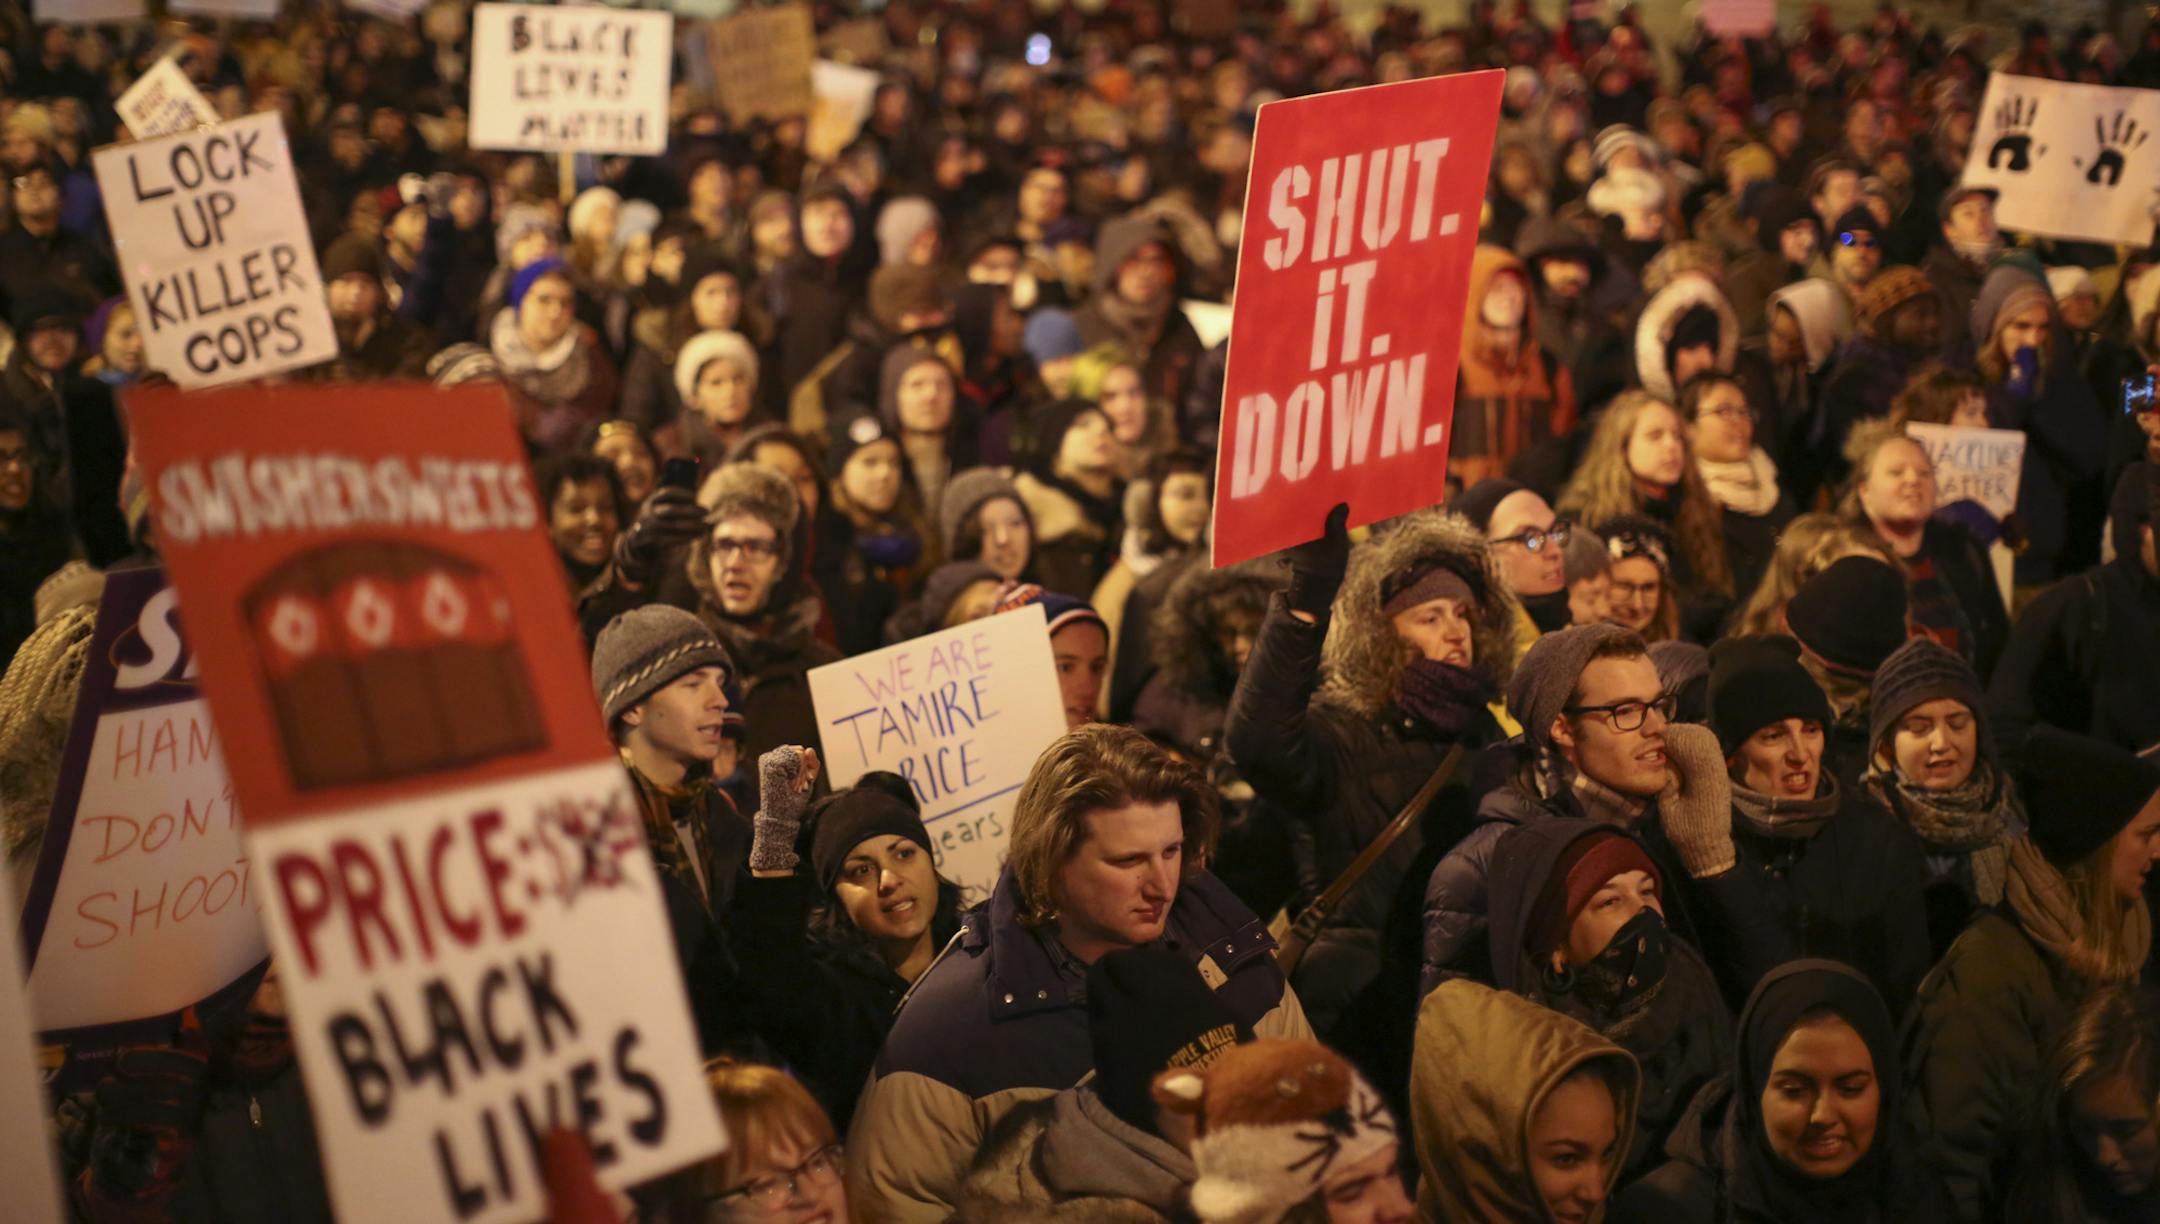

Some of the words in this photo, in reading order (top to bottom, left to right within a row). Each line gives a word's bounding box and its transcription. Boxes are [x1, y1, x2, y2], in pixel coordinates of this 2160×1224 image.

[511, 14, 637, 58] BLACK
[514, 61, 630, 101] LIVES
[127, 129, 274, 203] LOCK
[173, 190, 236, 250] UP
[1263, 137, 1460, 271] SHUT.
[141, 244, 307, 332] KILLER
[185, 303, 304, 374] COPS
[1230, 352, 1444, 500] DOWN.
[855, 652, 914, 701] WE
[927, 632, 993, 684] ARE
[832, 674, 1000, 768] TAMIRE
[899, 738, 987, 805] RICE
[74, 858, 252, 950] SHOOT
[326, 948, 580, 1130] BLACK
[1198, 1023, 1238, 1051] VALLEY
